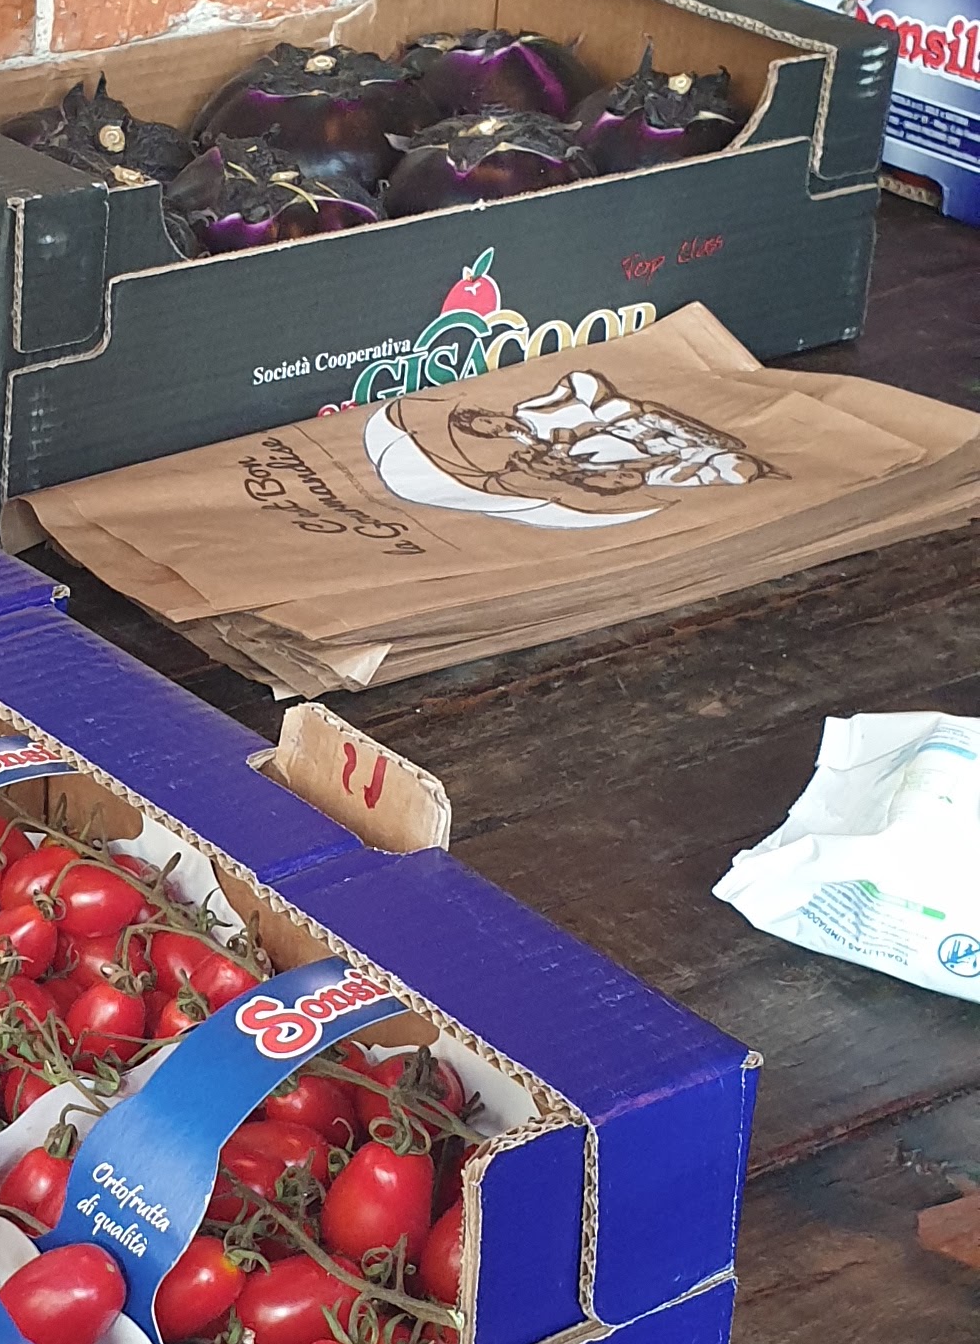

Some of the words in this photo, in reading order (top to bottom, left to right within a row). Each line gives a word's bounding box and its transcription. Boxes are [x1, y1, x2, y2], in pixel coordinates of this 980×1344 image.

[252, 357, 312, 386] Società
[315, 335, 412, 374] Cooperativa
[238, 455, 287, 502] Bon
[262, 436, 410, 539] Gourmandise
[76, 1193, 101, 1222] di
[92, 1210, 149, 1259] qualità
[91, 1160, 172, 1233] Ortofrutta
